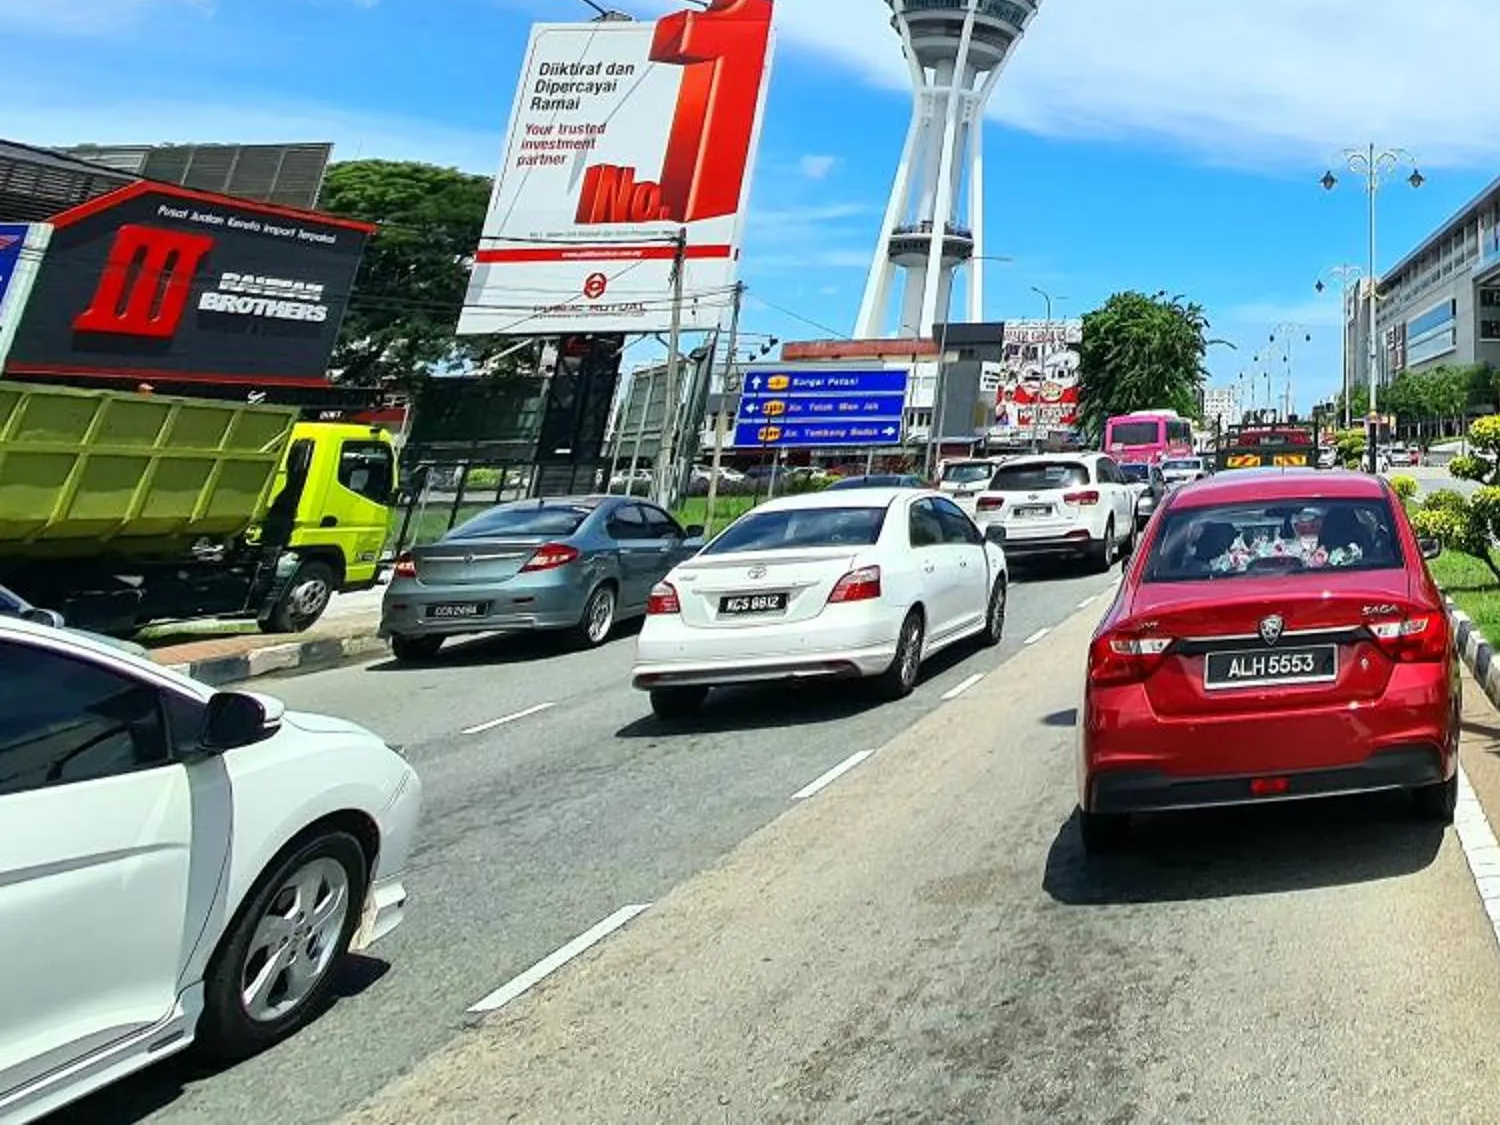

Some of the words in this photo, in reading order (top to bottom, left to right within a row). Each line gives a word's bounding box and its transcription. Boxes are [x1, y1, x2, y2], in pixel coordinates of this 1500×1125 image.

[539, 61, 603, 76] Diiktiraf
[605, 62, 635, 76] dan
[534, 79, 617, 96] Dipercayai
[530, 96, 581, 111] Ramai
[525, 122, 554, 136] Your
[558, 122, 607, 135] trusted
[521, 138, 596, 150] investment
[516, 154, 567, 168] partner
[573, 163, 672, 224] No.
[198, 291, 328, 322] BROTHERS
[726, 597, 750, 612] KCS
[1361, 603, 1399, 616] SAGA
[1227, 656, 1265, 678] ALH
[1267, 653, 1315, 674] 5553
